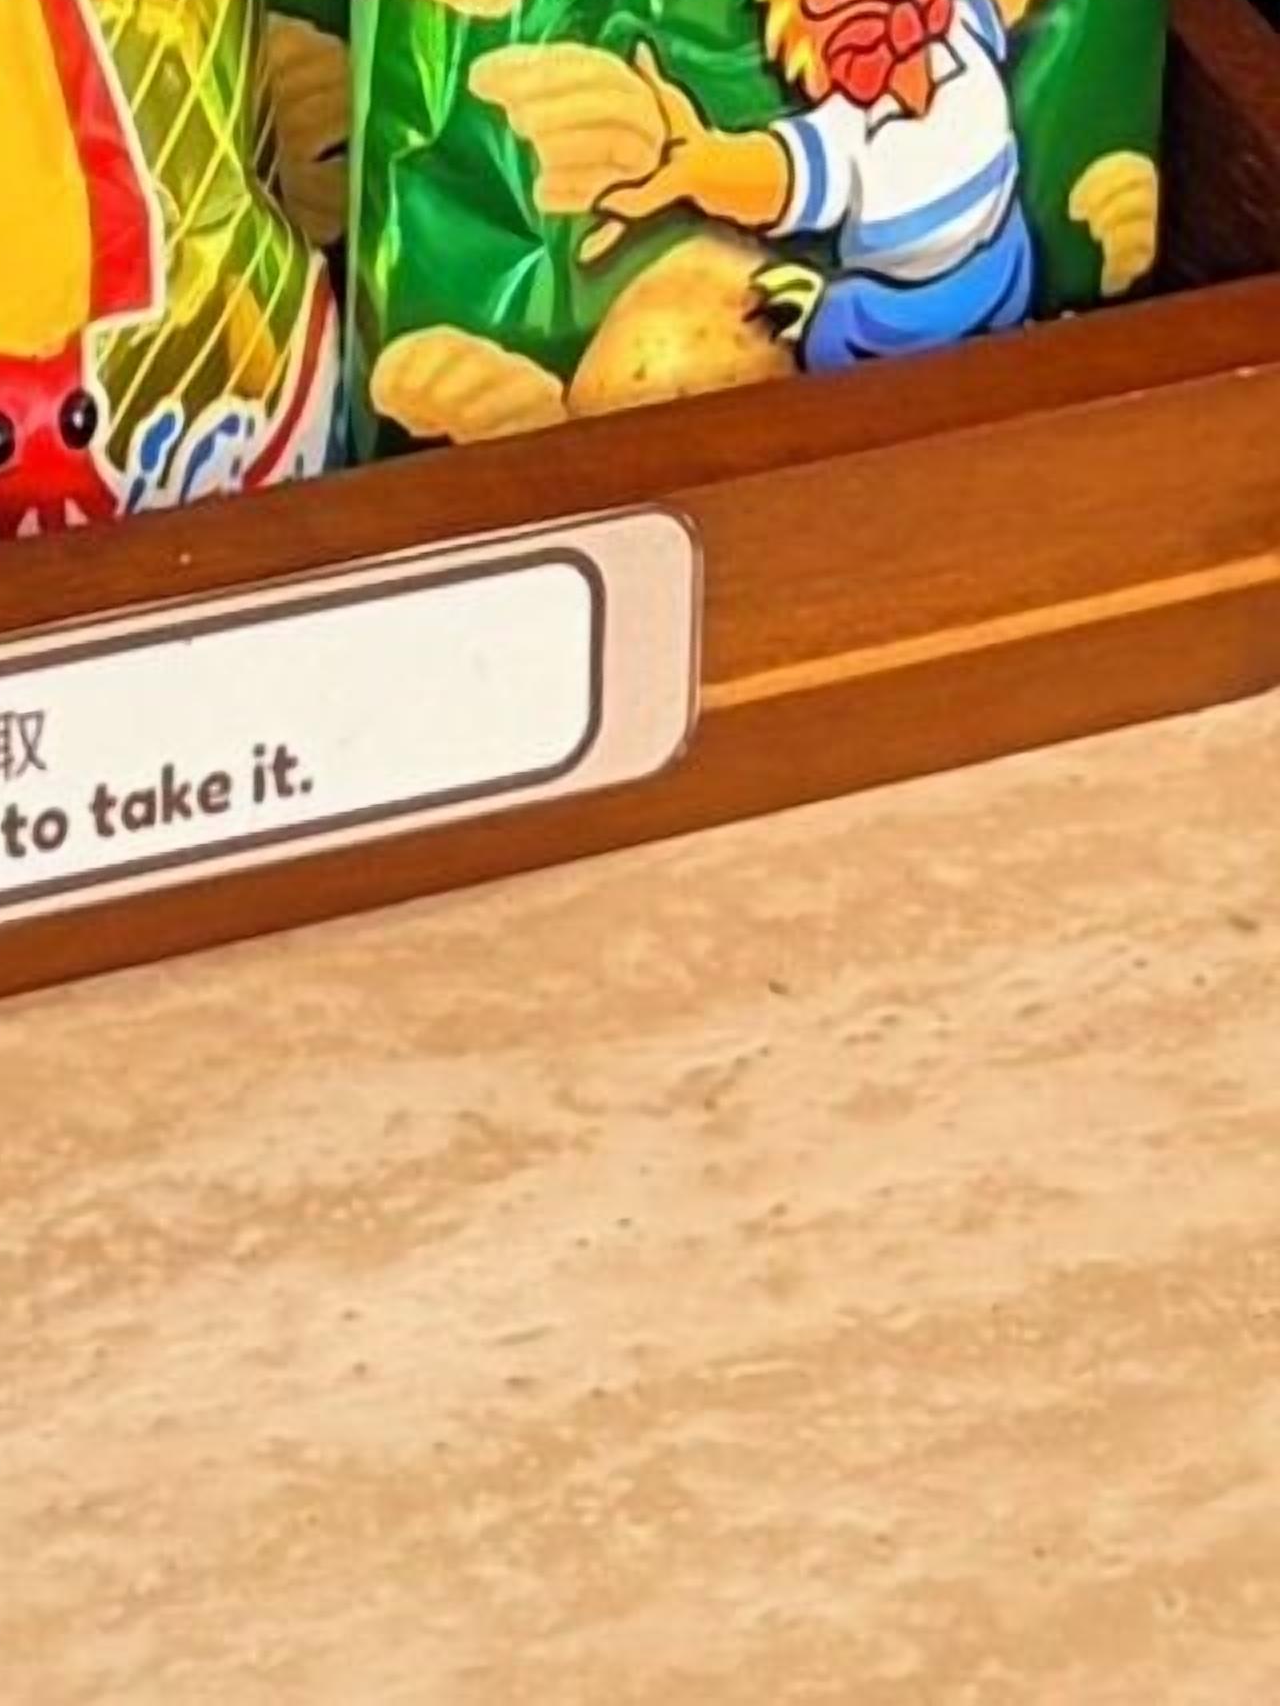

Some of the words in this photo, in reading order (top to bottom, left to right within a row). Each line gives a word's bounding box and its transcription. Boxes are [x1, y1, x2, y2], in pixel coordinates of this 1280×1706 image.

[0, 802, 69, 858] to
[88, 762, 234, 837] take
[251, 742, 314, 804] it.
